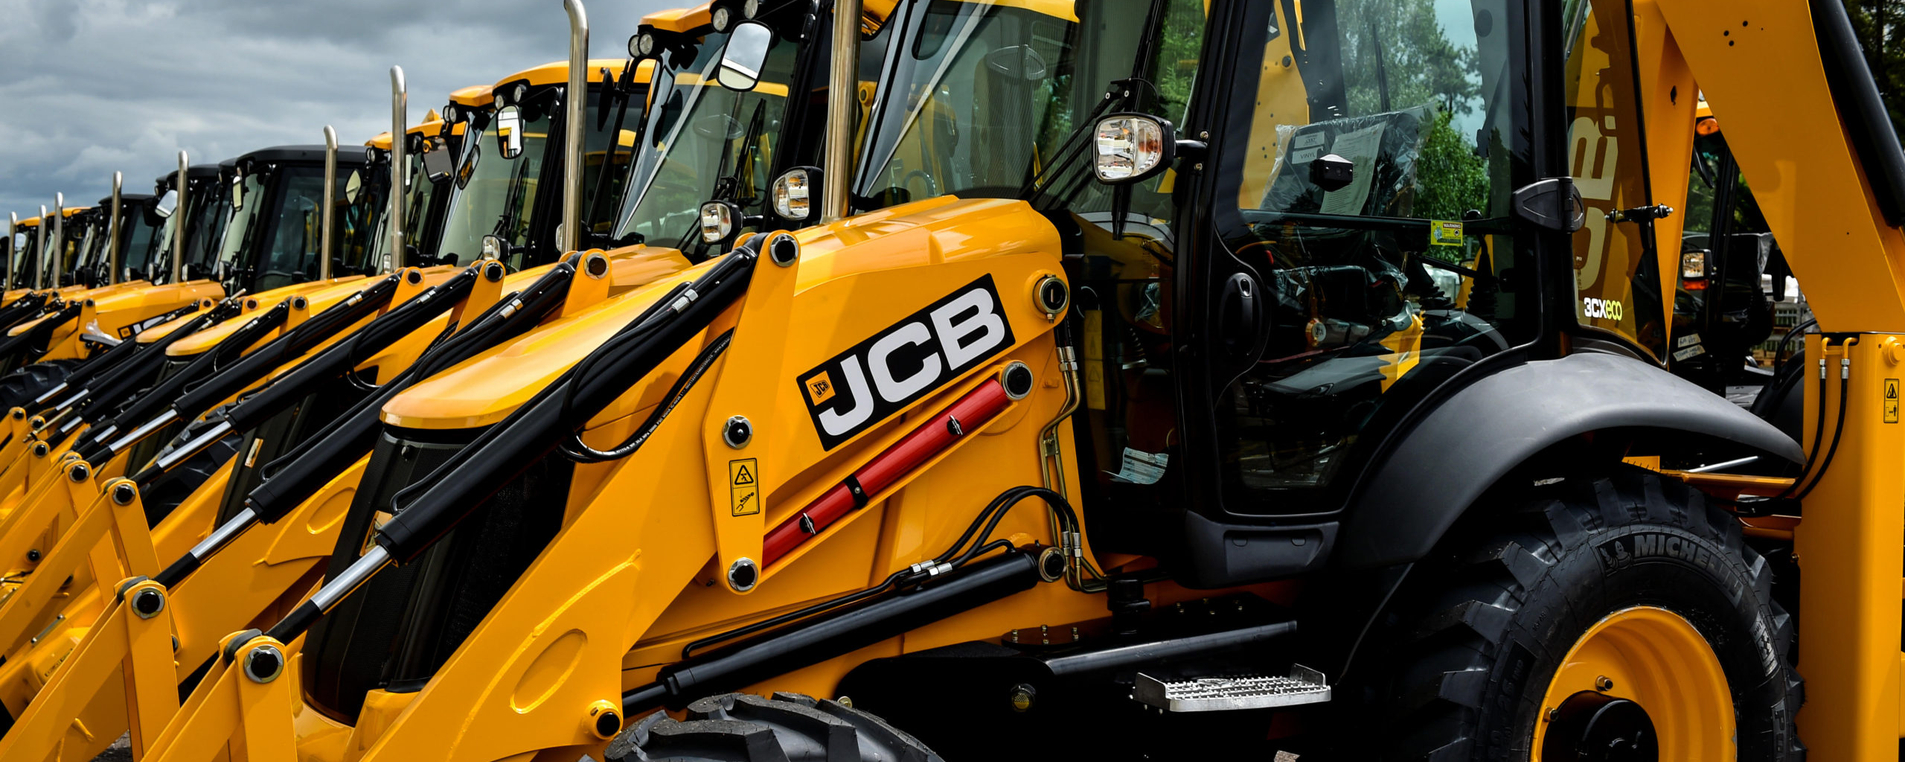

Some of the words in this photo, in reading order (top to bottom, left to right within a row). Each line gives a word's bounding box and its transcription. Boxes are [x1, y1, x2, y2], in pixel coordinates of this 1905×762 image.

[1583, 297, 1623, 321] 3CXeco
[818, 287, 1006, 436] JCB
[814, 382, 829, 396] JCB
[1634, 534, 1742, 598] MICHELIN
